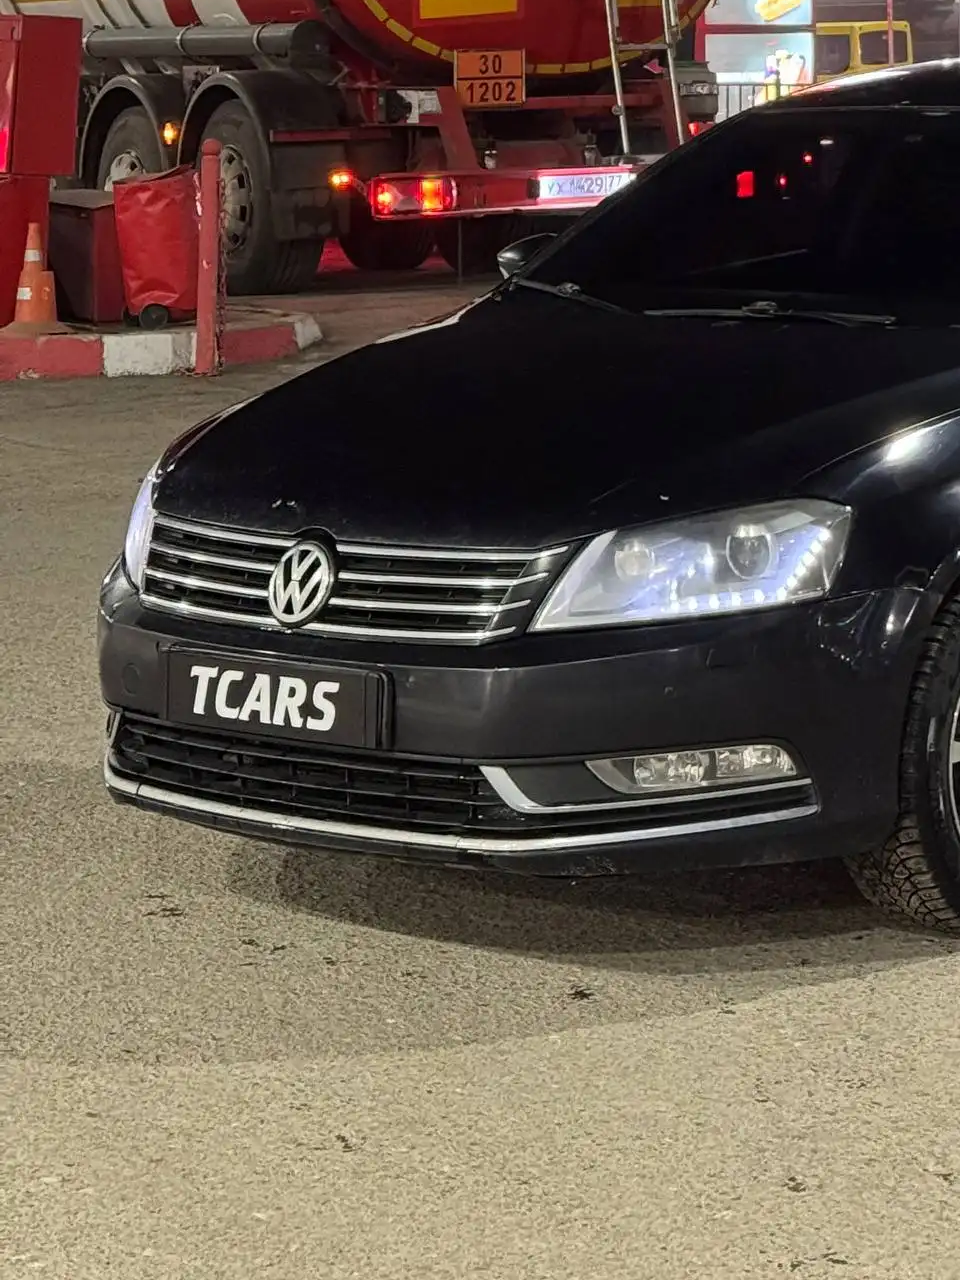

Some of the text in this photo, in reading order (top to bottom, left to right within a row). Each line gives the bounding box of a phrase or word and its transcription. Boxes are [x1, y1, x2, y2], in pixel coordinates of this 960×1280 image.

[478, 54, 502, 74] 30
[467, 81, 516, 103] 1202
[190, 665, 340, 732] TCARS
